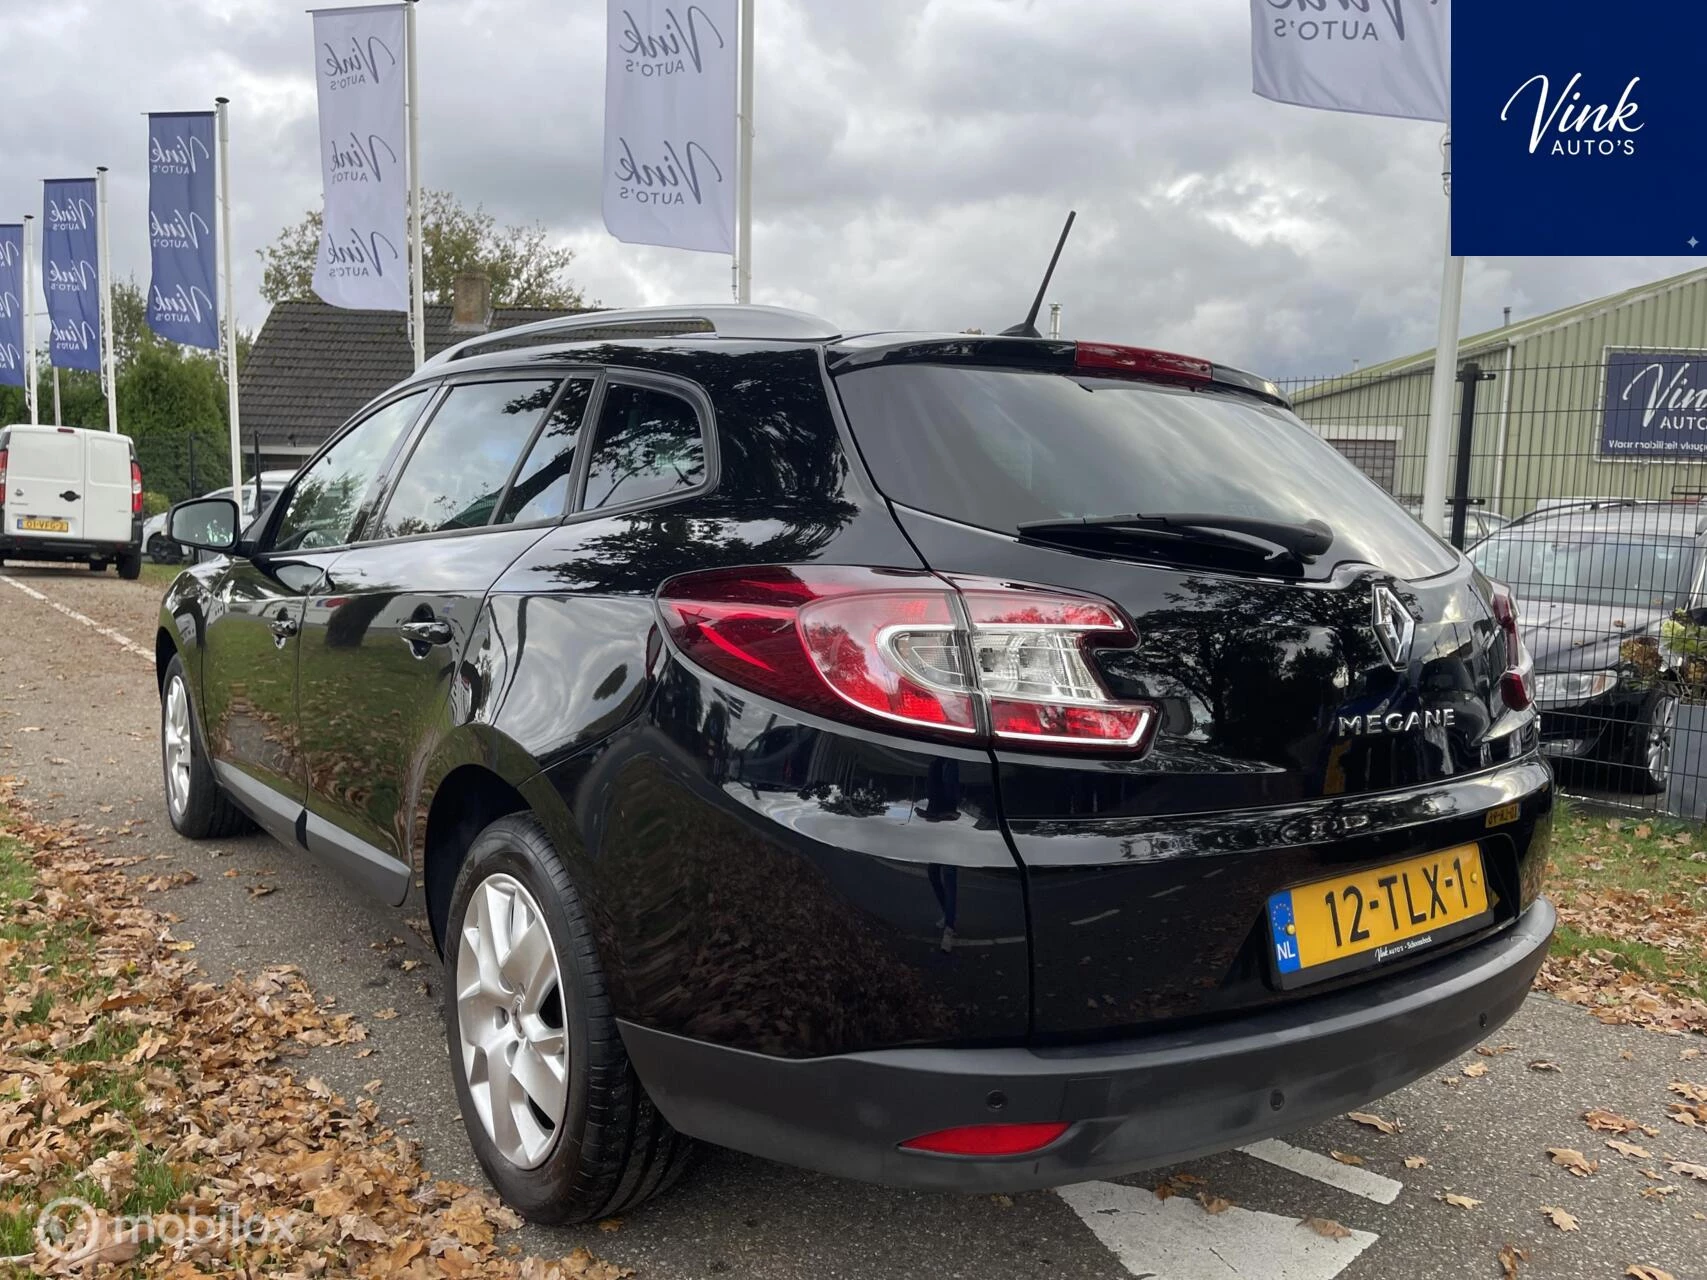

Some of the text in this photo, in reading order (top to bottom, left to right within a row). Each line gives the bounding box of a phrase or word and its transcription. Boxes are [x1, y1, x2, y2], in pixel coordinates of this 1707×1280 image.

[1680, 441, 1707, 453] vleug
[1338, 709, 1456, 736] MEGANE
[1324, 858, 1468, 948] 12-TLX-1
[1276, 941, 1296, 961] NL
